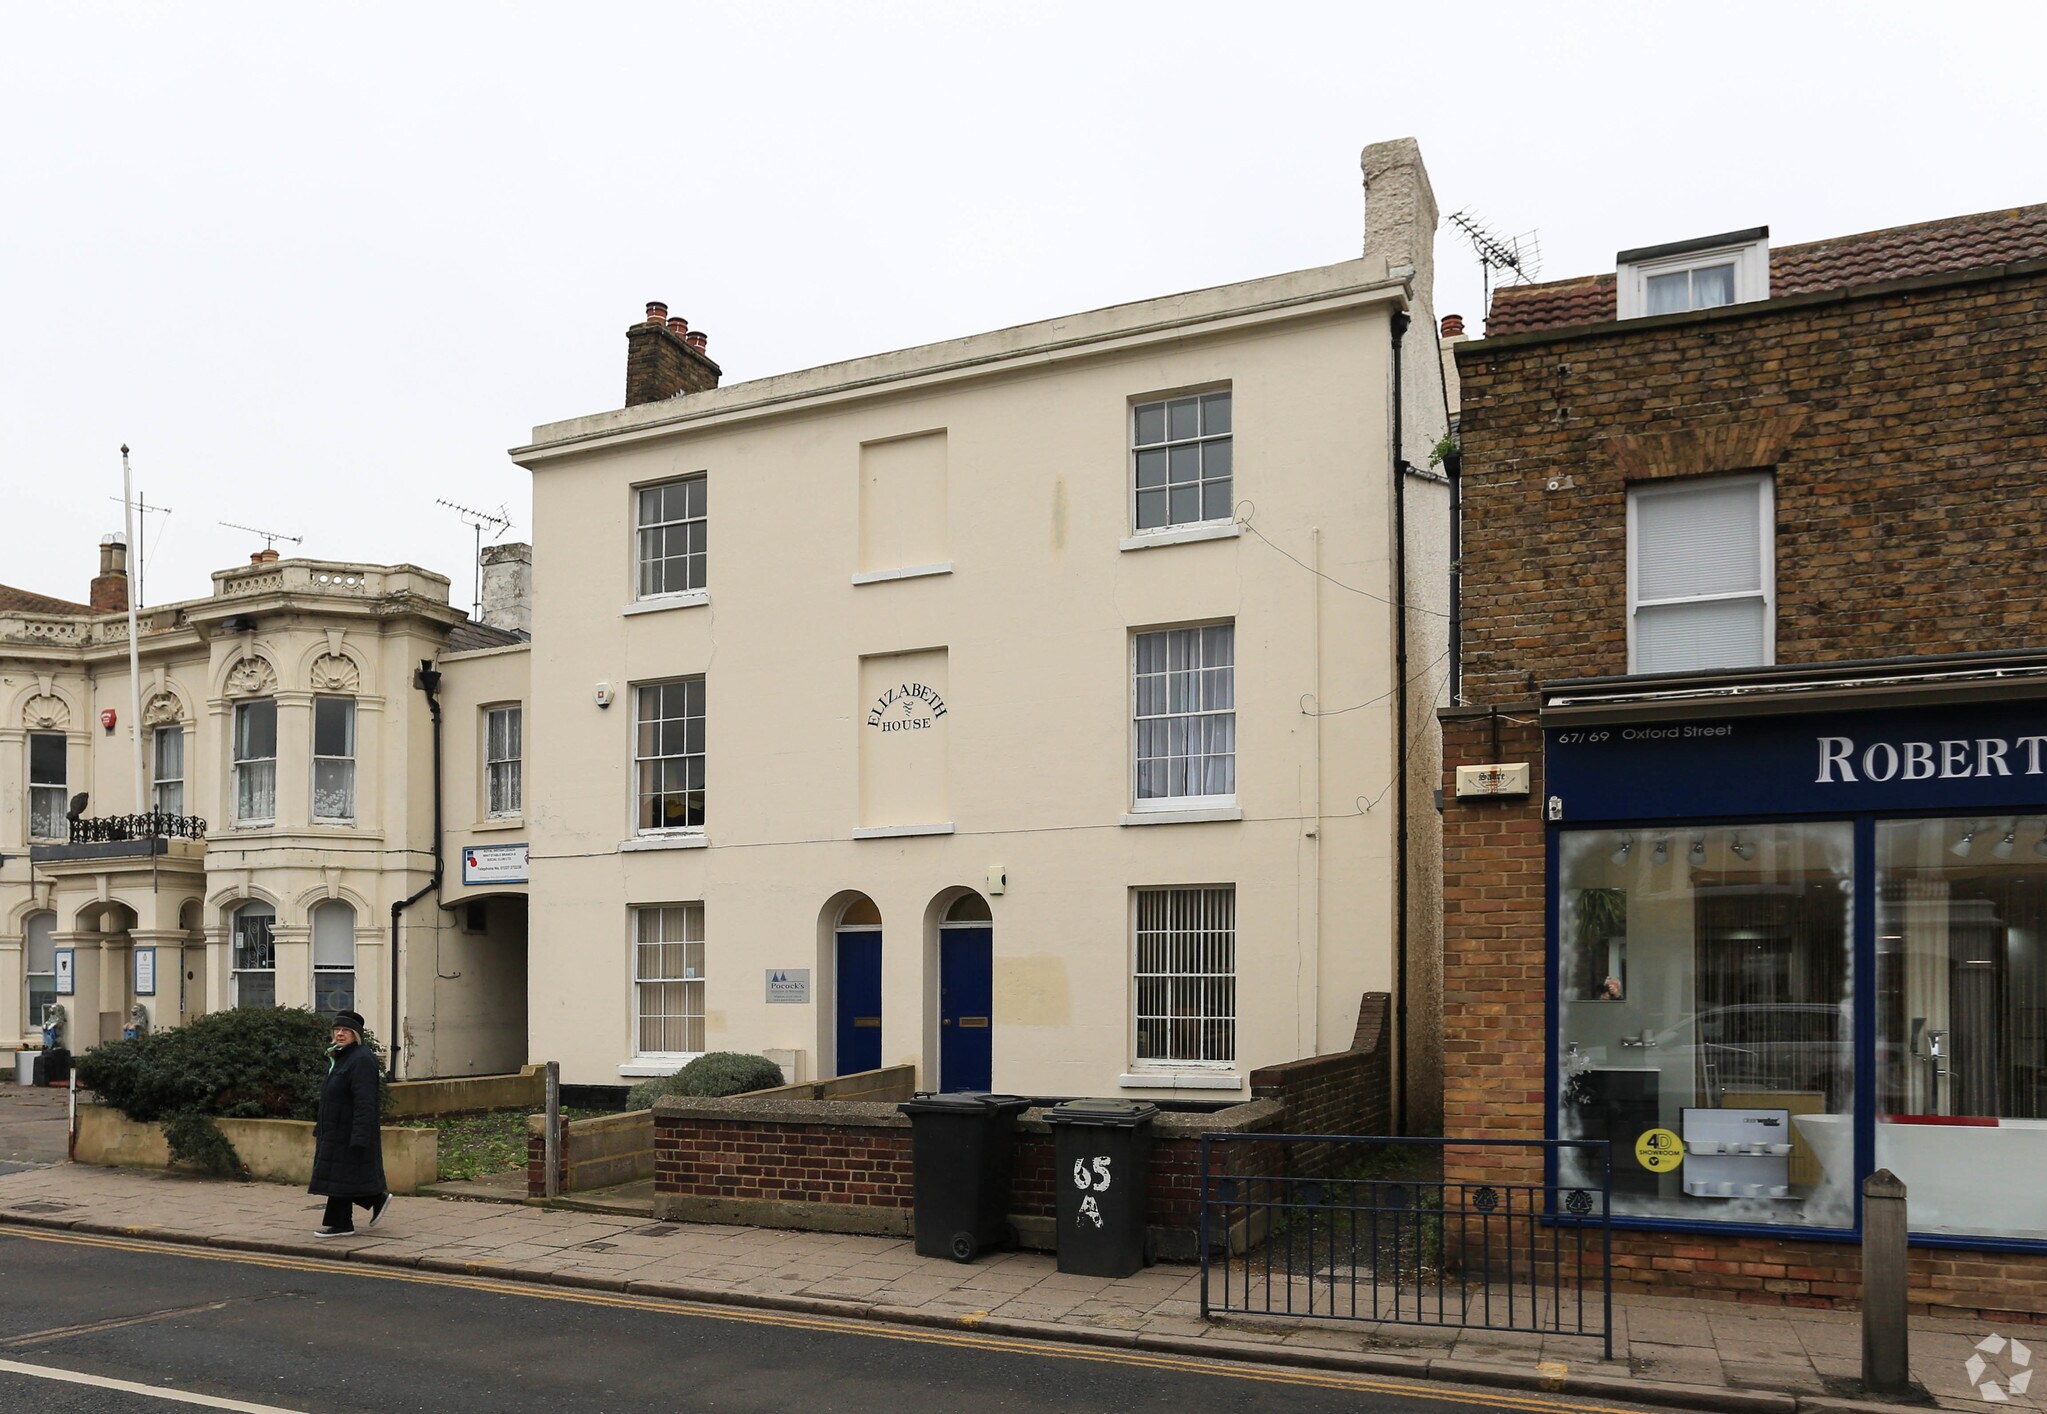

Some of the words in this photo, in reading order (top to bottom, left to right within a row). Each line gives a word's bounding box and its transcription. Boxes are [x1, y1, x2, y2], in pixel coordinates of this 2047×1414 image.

[867, 682, 948, 728] ELIZABETH
[881, 717, 931, 732] HOUSE
[1622, 727, 1679, 740] Oxford
[1683, 724, 1732, 737] Street
[1814, 735, 2047, 783] ROBERT
[1647, 1133, 1671, 1149] 4D
[1072, 1156, 1112, 1193] 65
[1075, 1194, 1104, 1230] A
